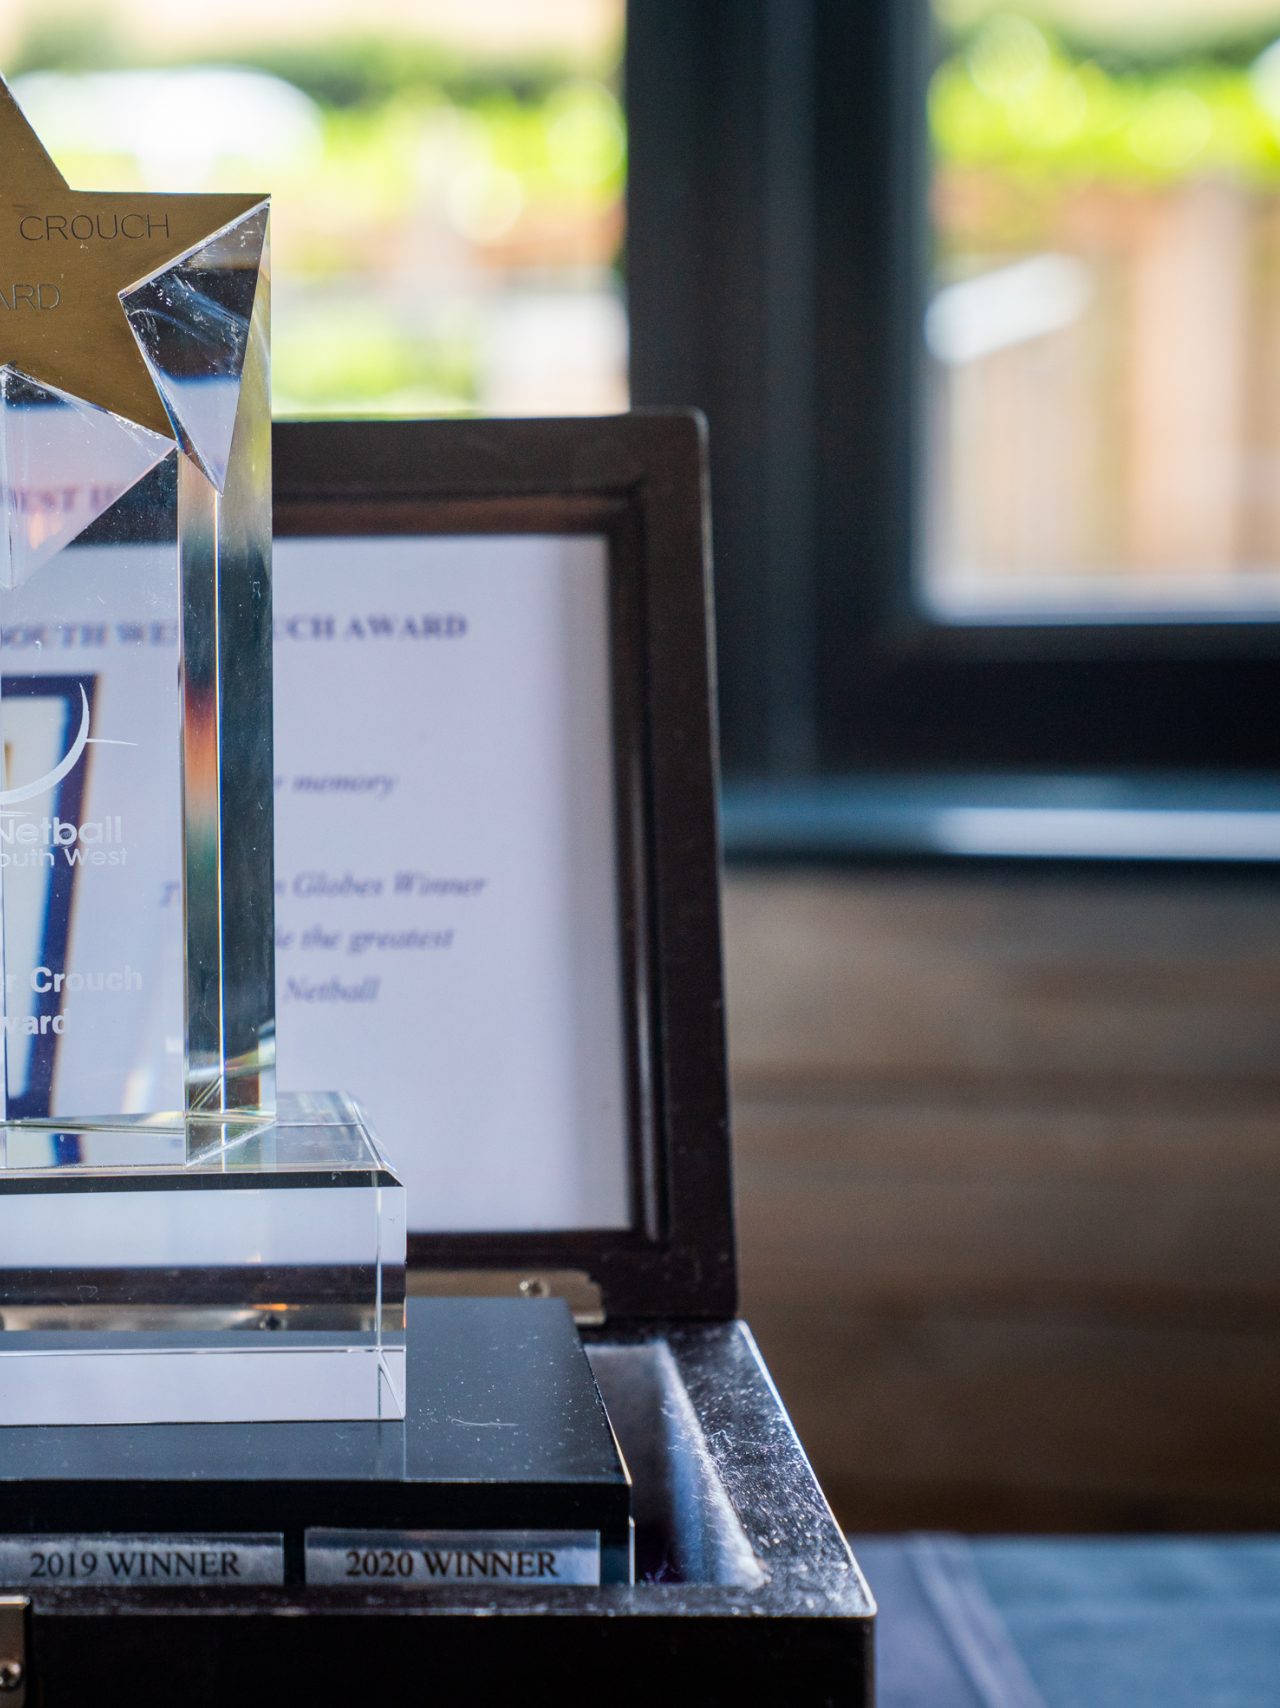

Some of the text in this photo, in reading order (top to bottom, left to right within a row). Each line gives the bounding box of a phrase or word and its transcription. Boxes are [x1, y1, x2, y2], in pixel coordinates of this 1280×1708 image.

[18, 213, 170, 242] CROUCH
[344, 613, 468, 640] AWARD
[64, 847, 128, 867] West
[393, 872, 488, 897] Winner
[30, 965, 143, 993] Crouch
[30, 1551, 242, 1578] 2019 WINNER
[345, 1550, 558, 1578] 2020 WINNER
